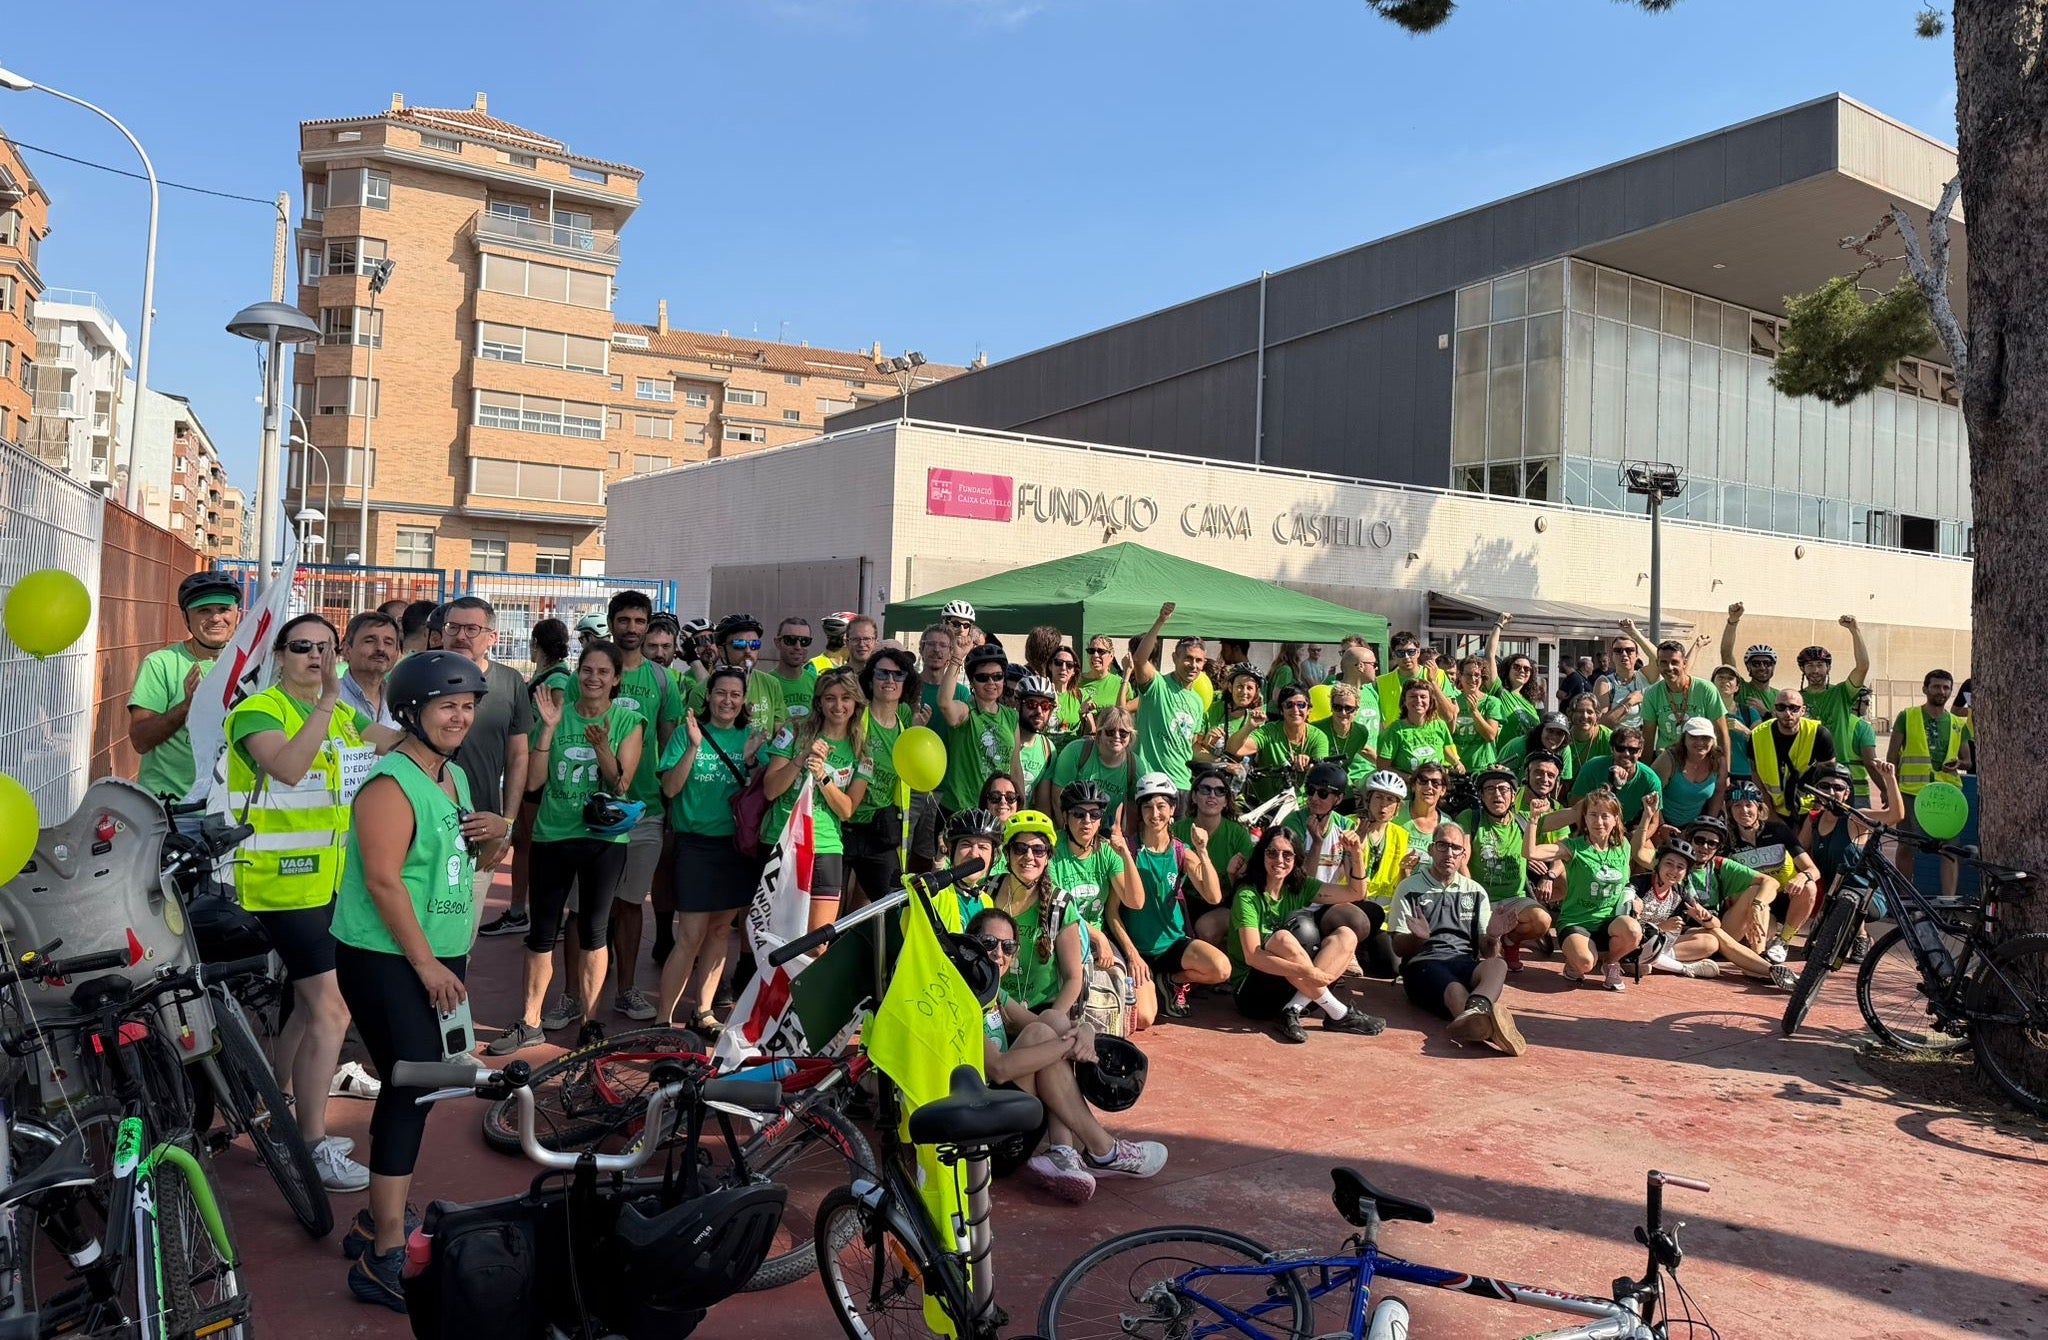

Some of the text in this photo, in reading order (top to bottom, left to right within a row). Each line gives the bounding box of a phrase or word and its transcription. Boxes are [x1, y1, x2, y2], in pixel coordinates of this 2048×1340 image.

[958, 494, 979, 504] CAIXA
[1180, 502, 1251, 541] CAIXA
[342, 750, 375, 761] INSPEC
[280, 857, 314, 868] VAGA
[426, 898, 469, 915] L'ESCOL
